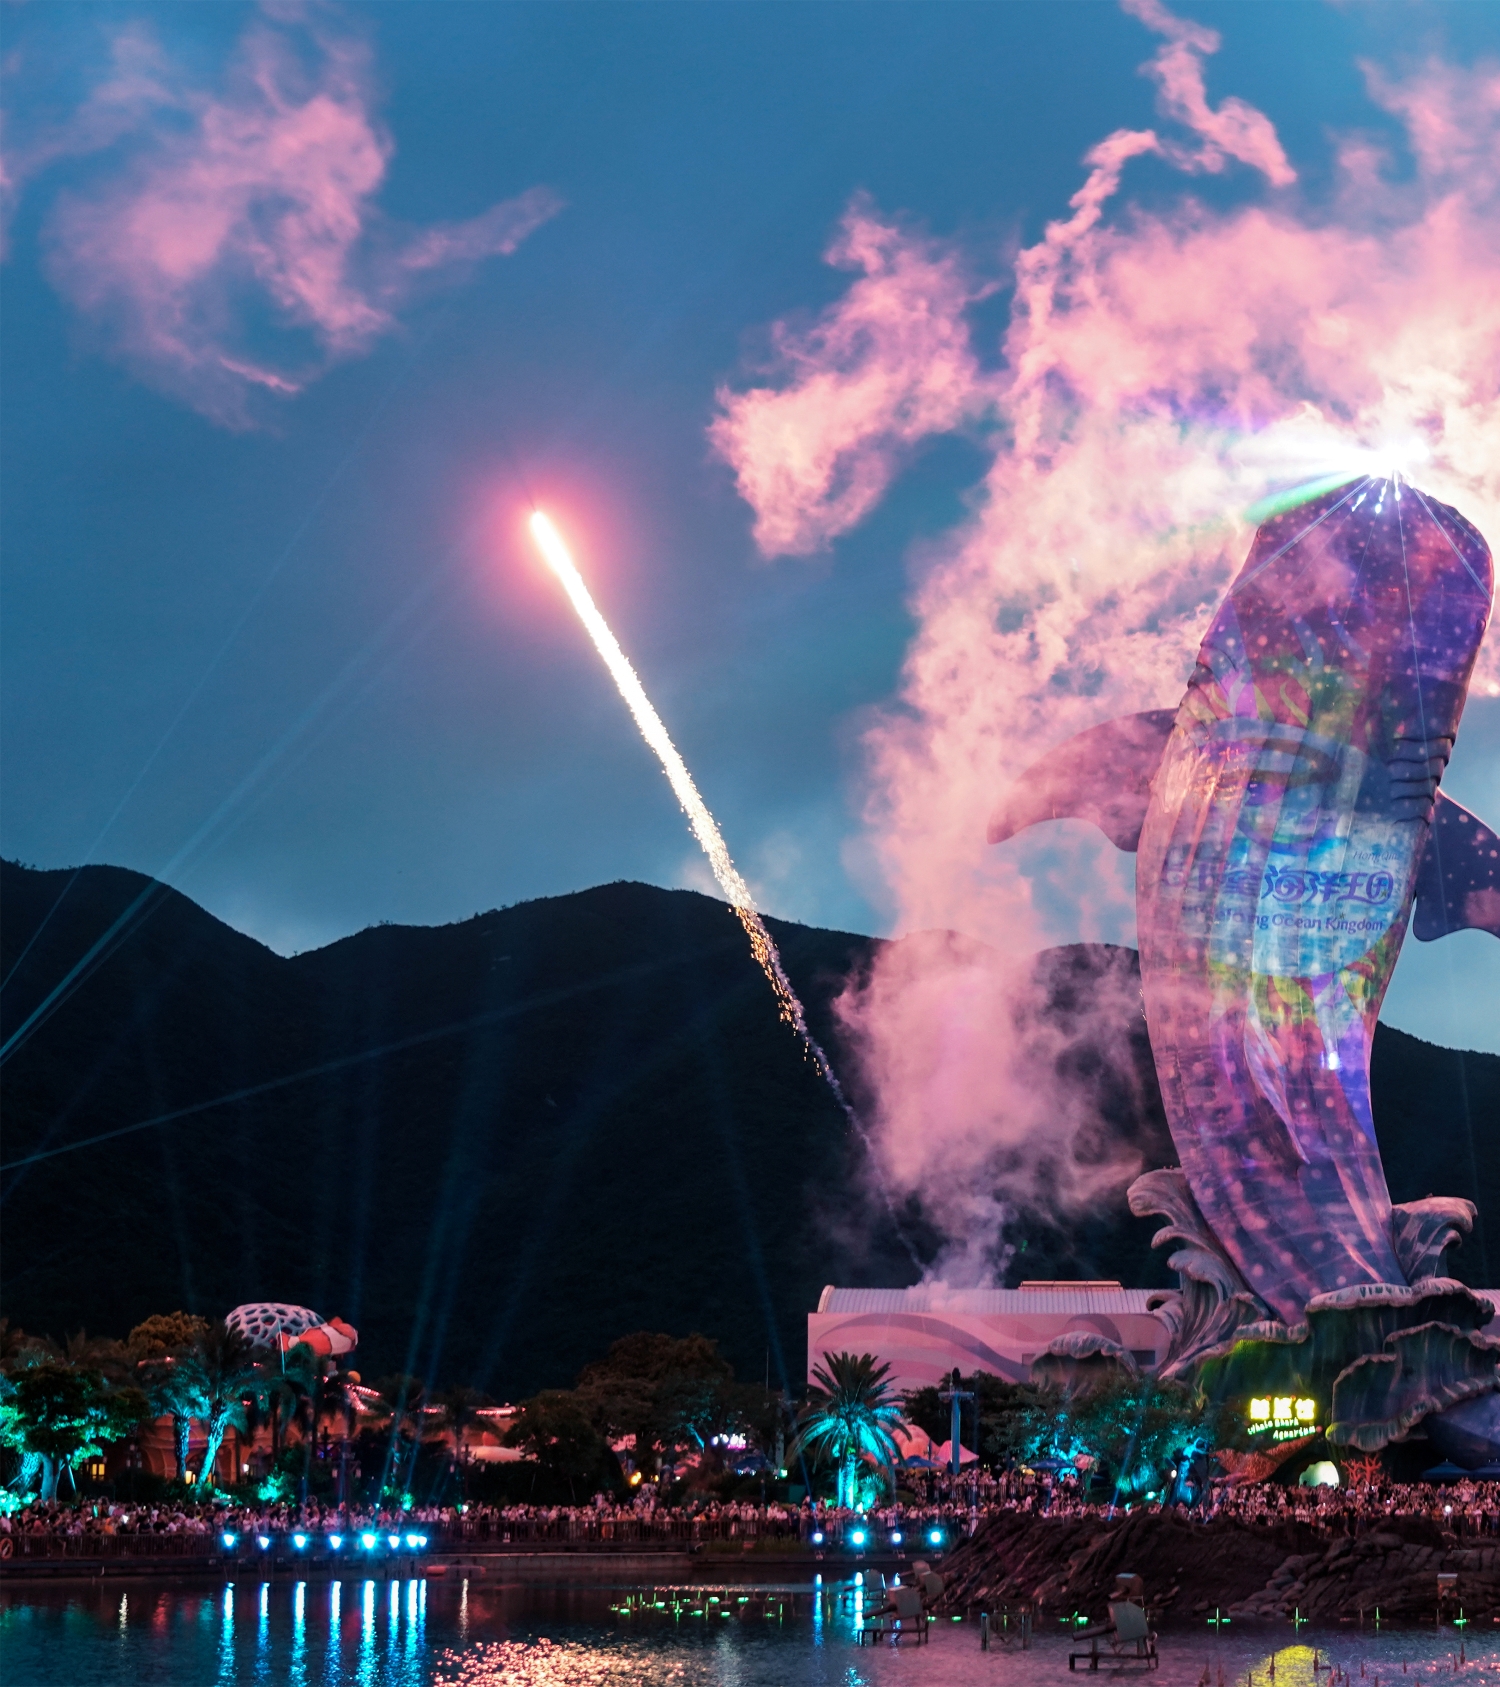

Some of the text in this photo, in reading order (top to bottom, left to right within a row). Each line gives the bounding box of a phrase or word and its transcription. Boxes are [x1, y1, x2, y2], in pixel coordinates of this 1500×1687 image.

[1272, 912, 1321, 929] Ocean
[1325, 916, 1383, 935] Kingdom
[1273, 1426, 1316, 1440] Aquarium
